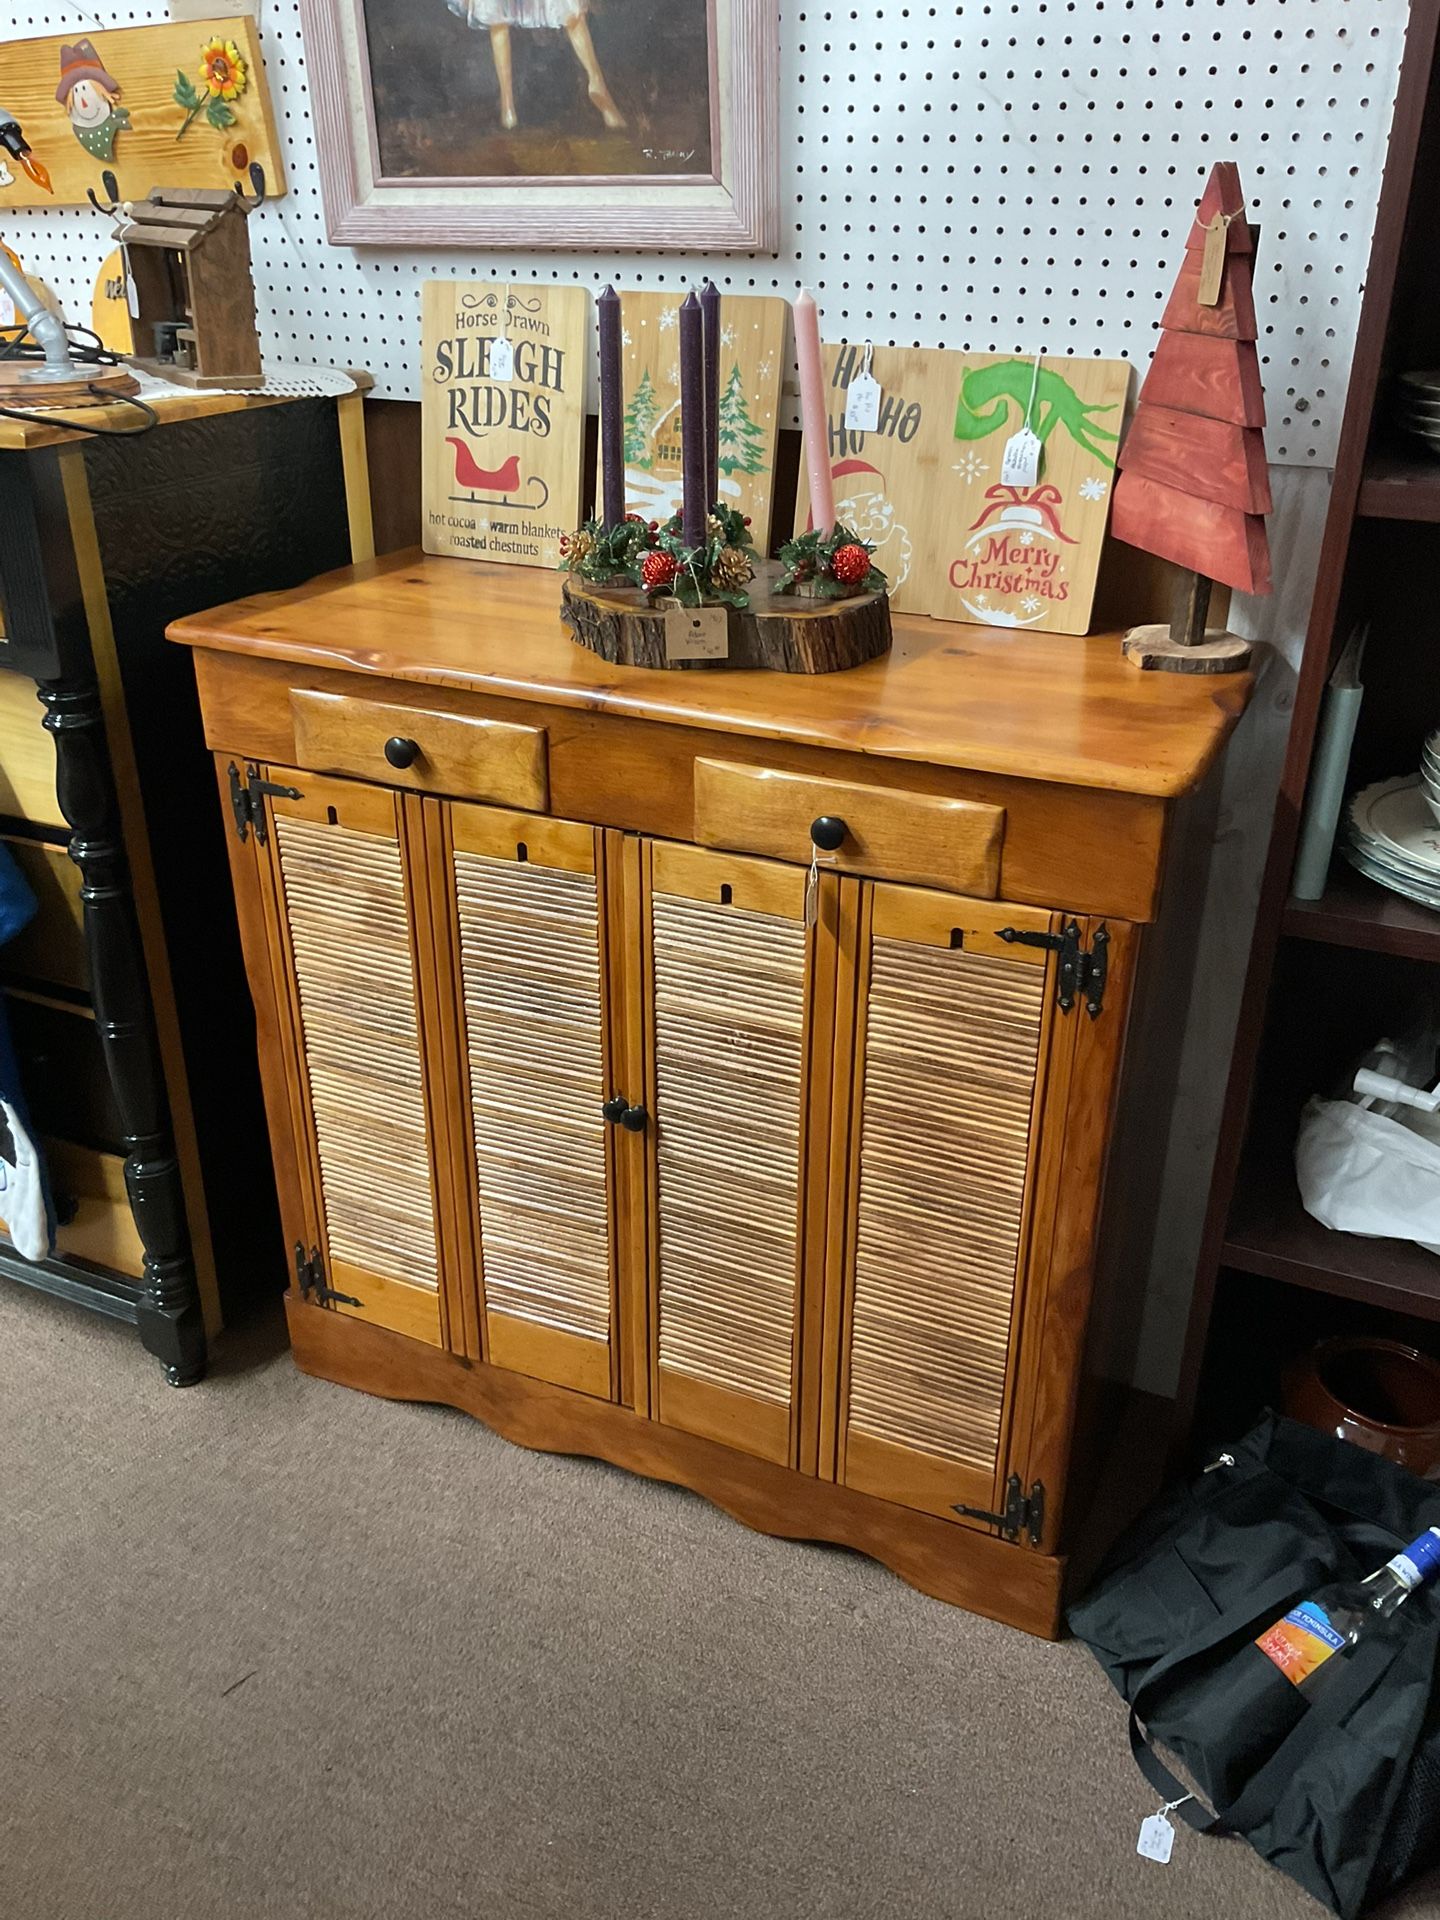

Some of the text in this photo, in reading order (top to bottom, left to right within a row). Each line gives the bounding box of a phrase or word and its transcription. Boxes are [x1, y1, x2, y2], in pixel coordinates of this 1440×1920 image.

[456, 312, 498, 330] Horse
[432, 337, 566, 393] SLEGH
[447, 386, 551, 437] RIDES
[877, 396, 922, 443] HO
[428, 511, 567, 539] hot cocoa warm blankets
[450, 535, 540, 556] roasted chestnuts
[980, 536, 1061, 578] Merry
[949, 559, 1070, 600] Christmas
[1271, 1627, 1303, 1661] Sunset
[1301, 1612, 1339, 1646] PENINSULA
[1262, 1637, 1290, 1668] Splash
